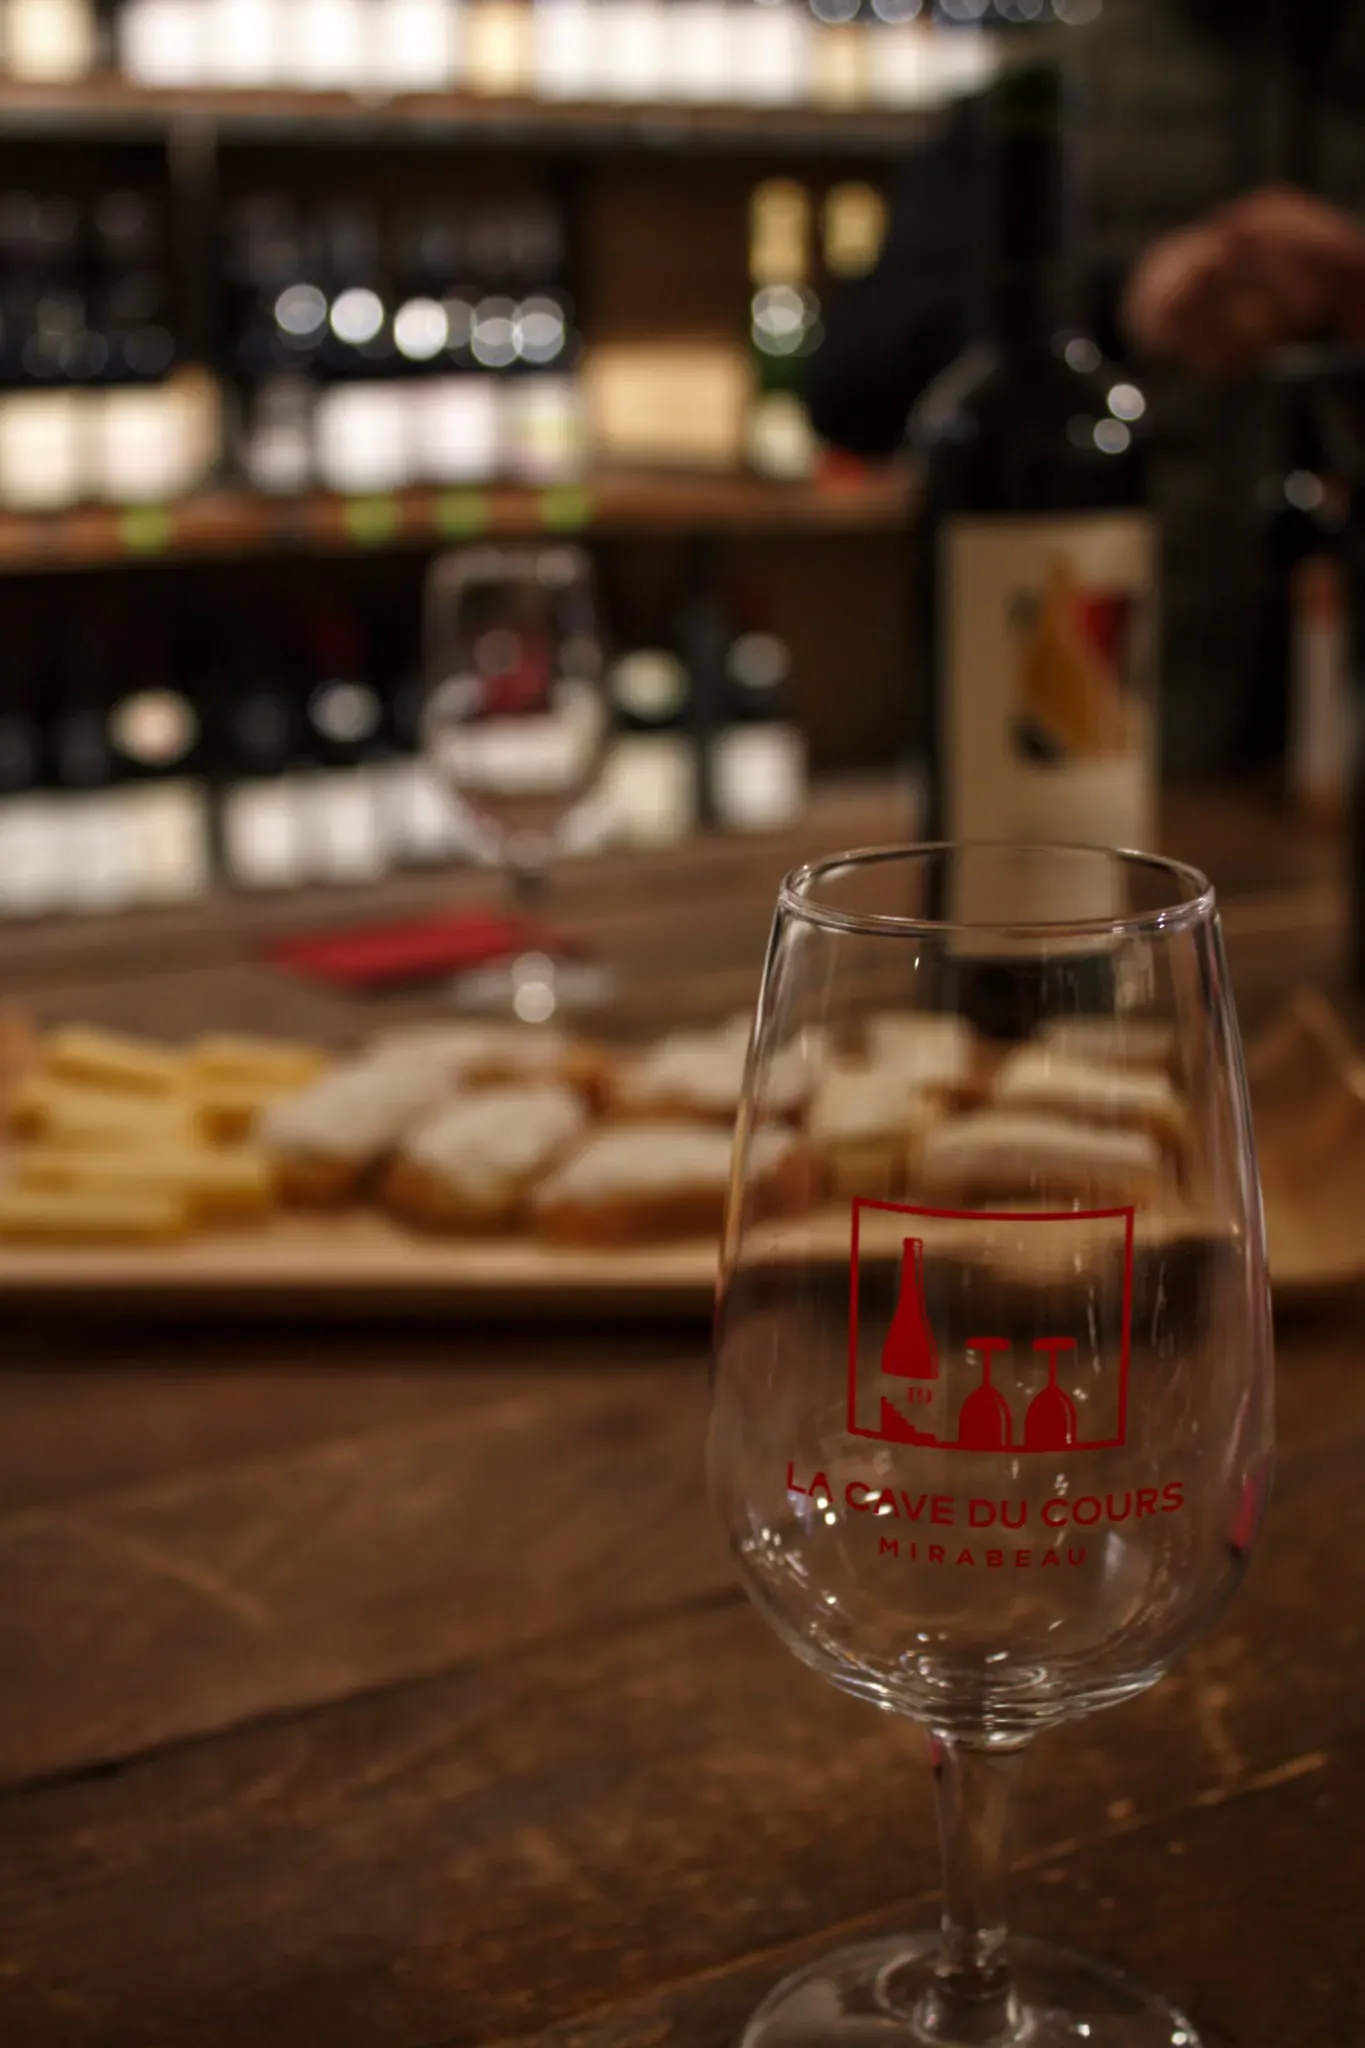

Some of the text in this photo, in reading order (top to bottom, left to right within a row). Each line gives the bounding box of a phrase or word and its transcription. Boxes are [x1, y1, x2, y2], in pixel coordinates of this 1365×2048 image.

[786, 1461, 1184, 1530] LA CAVE DU COURS
[879, 1537, 1087, 1568] MIRABEAU
